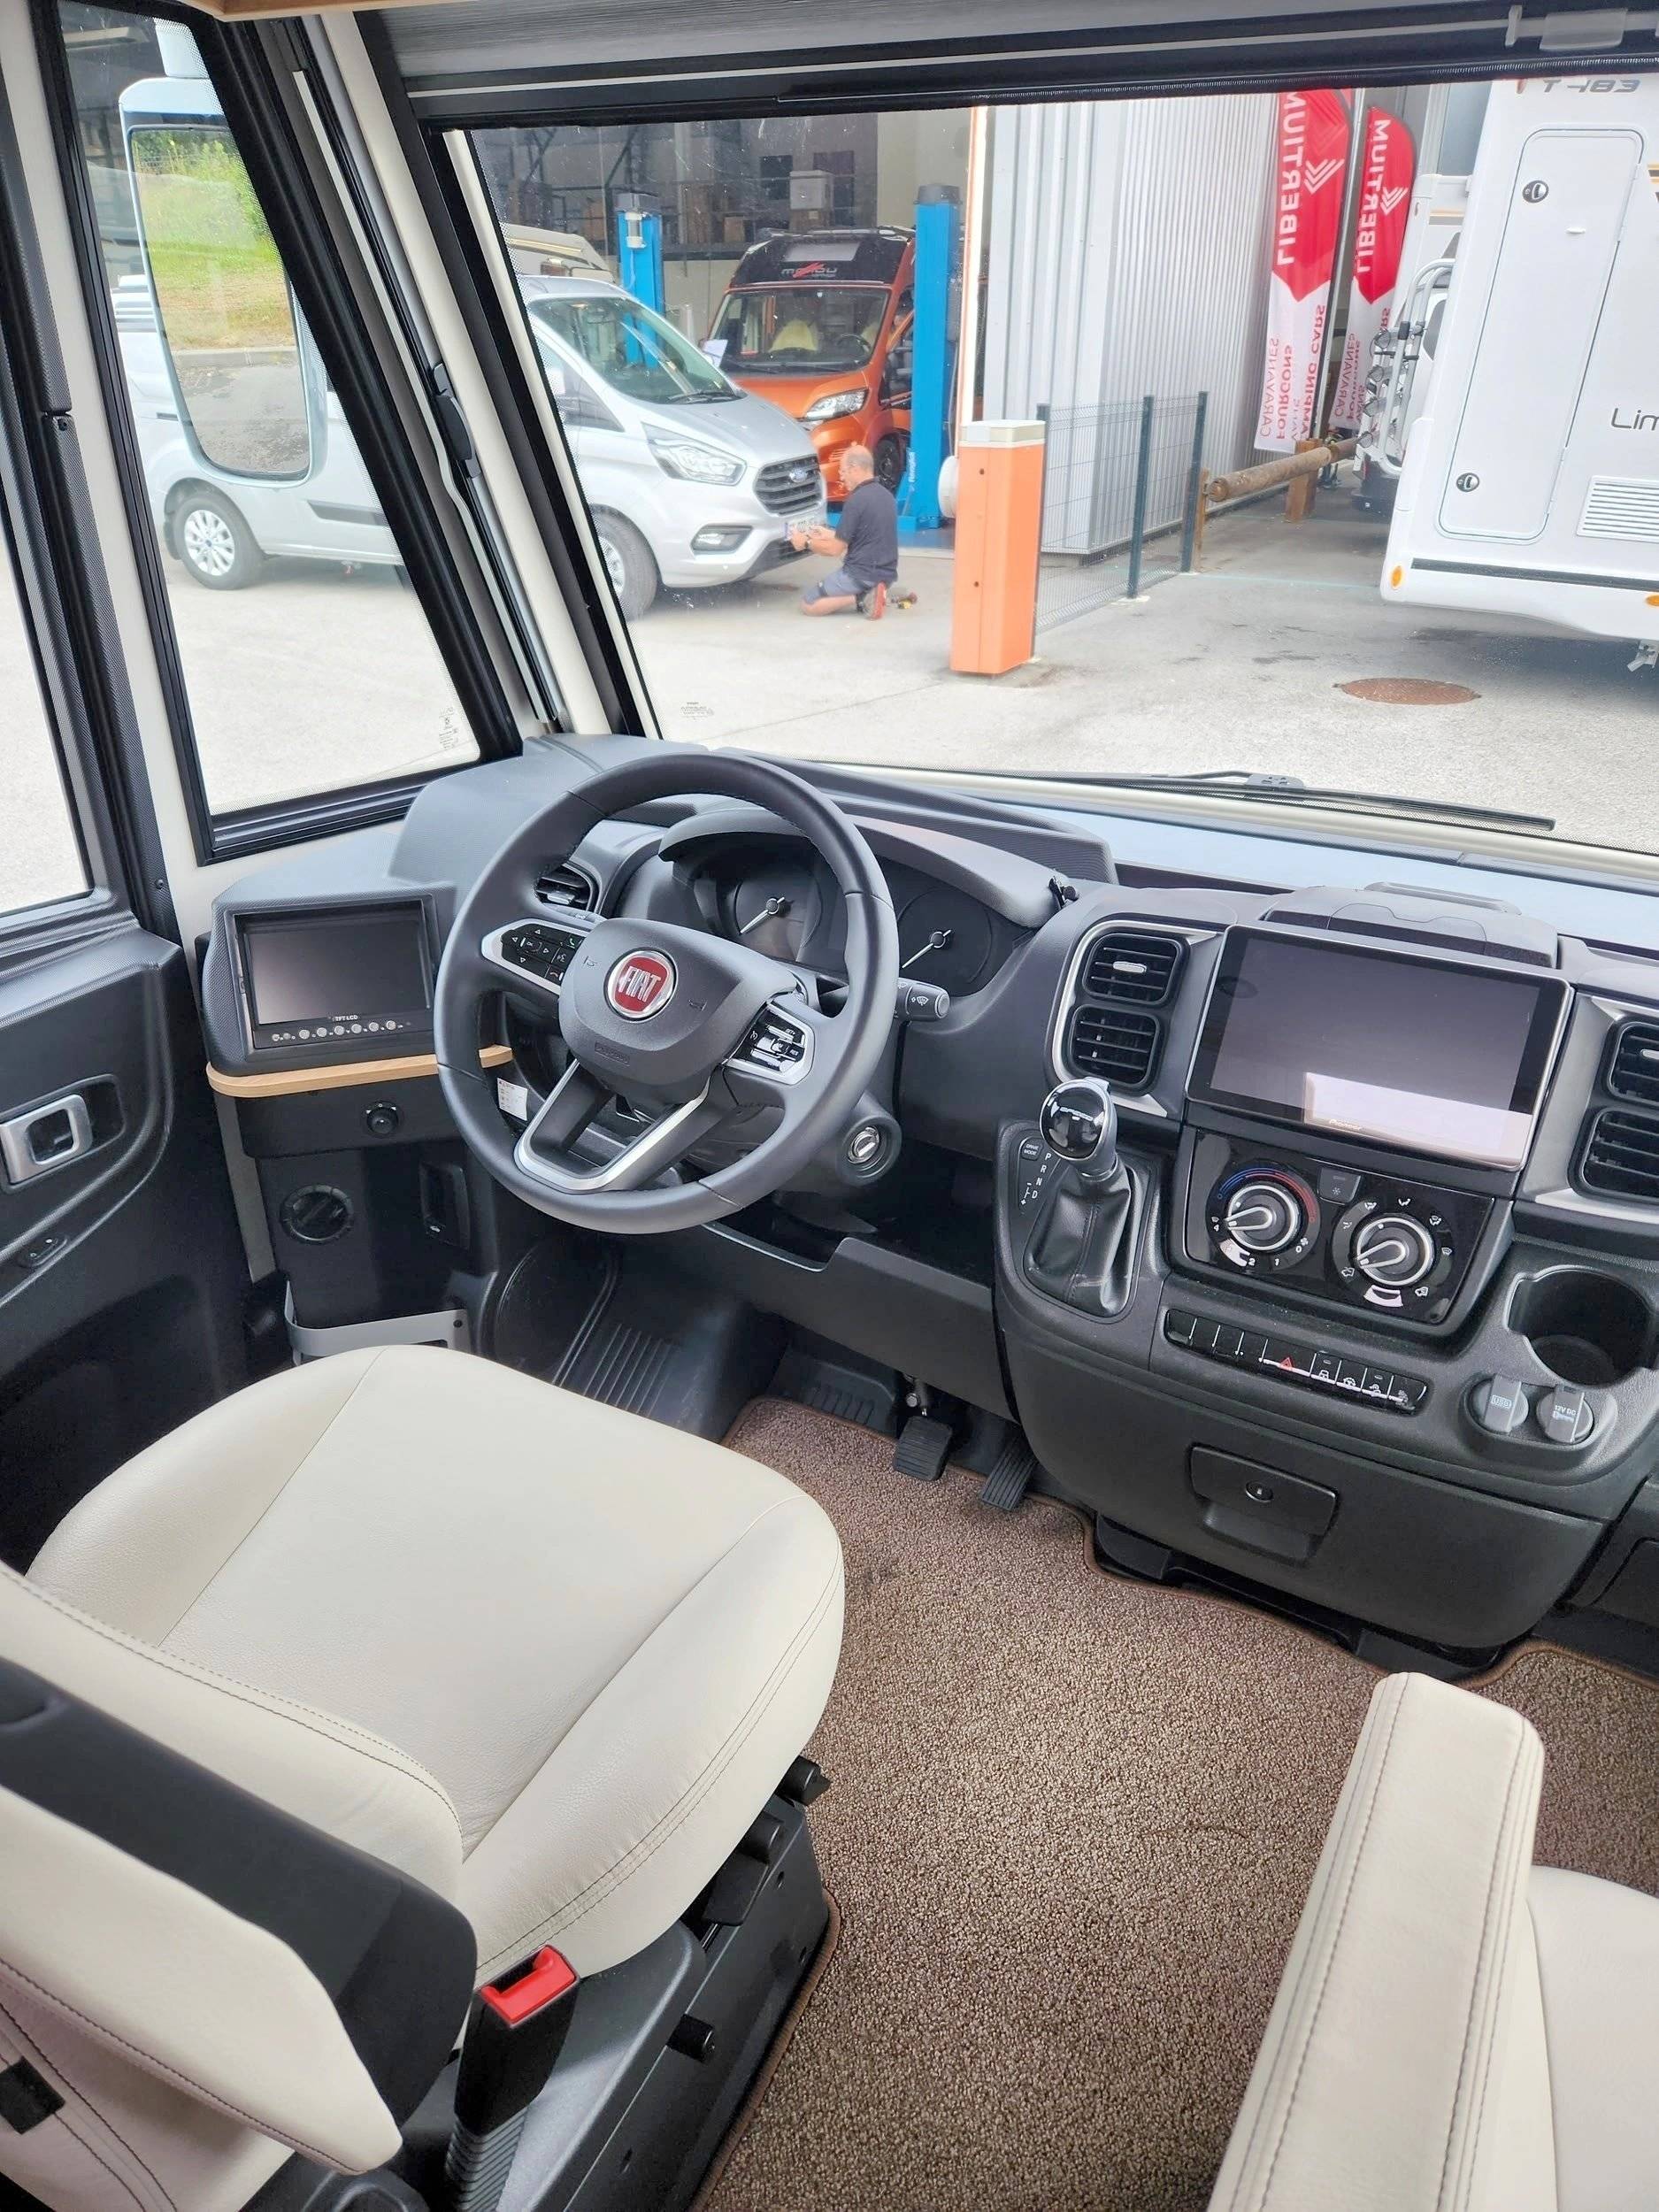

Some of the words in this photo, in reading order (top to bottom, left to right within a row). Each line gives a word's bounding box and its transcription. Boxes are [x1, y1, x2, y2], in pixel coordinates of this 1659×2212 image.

[618, 965, 662, 1002] FIAT
[1045, 1152, 1052, 1161] P
[1040, 1164, 1048, 1173] R
[1035, 1177, 1043, 1187] N
[1032, 1190, 1038, 1199] D
[1295, 1245, 1302, 1254] 0
[1248, 1257, 1256, 1266] 2
[1274, 1257, 1279, 1266] 1
